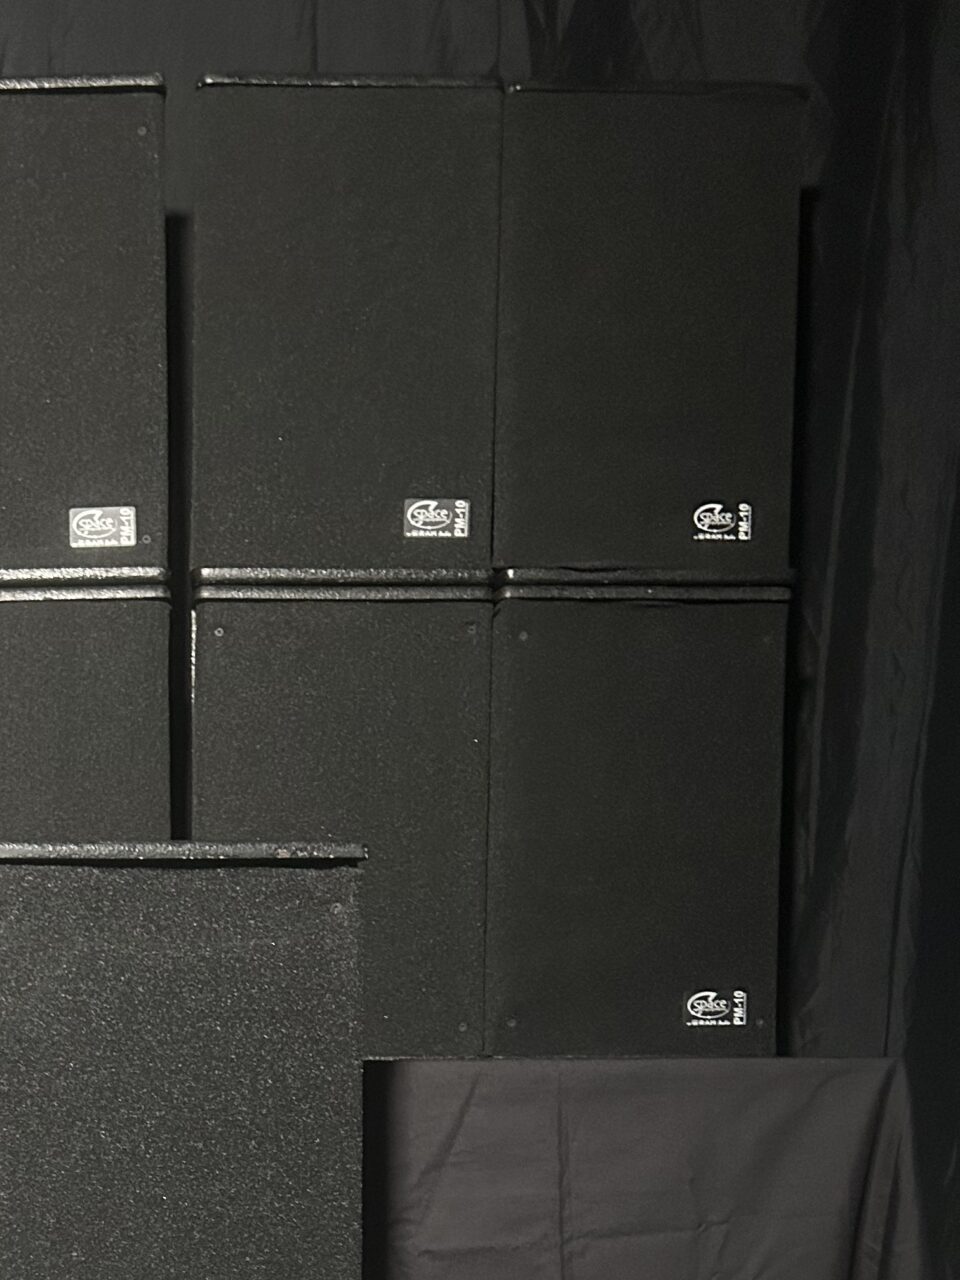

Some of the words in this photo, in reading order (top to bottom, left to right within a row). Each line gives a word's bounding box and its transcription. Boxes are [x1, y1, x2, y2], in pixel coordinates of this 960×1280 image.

[454, 500, 468, 537] PM-10
[738, 503, 751, 540] PM-10
[733, 990, 746, 1026] PM-10
